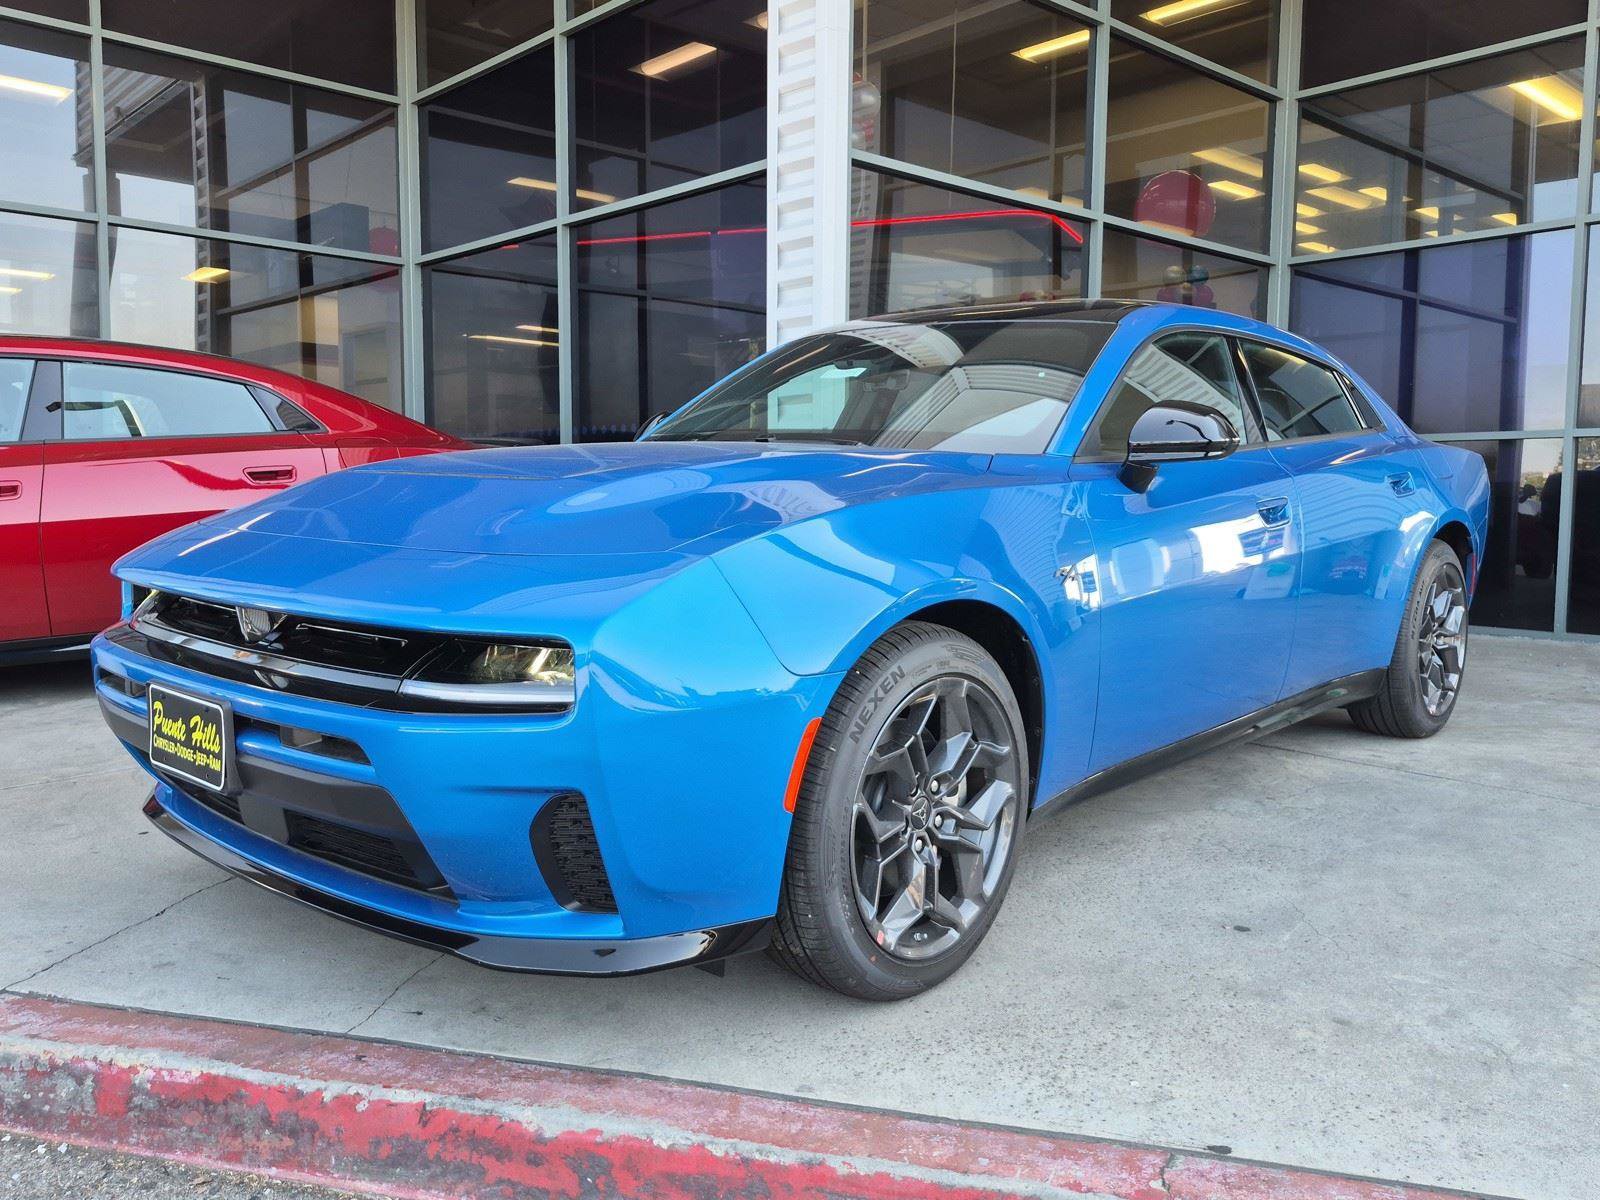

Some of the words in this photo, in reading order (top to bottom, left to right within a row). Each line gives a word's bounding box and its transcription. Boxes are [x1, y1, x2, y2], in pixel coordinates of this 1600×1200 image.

[153, 701, 187, 742] Puente
[190, 715, 221, 754] Hills
[849, 665, 905, 744] NEXEN
